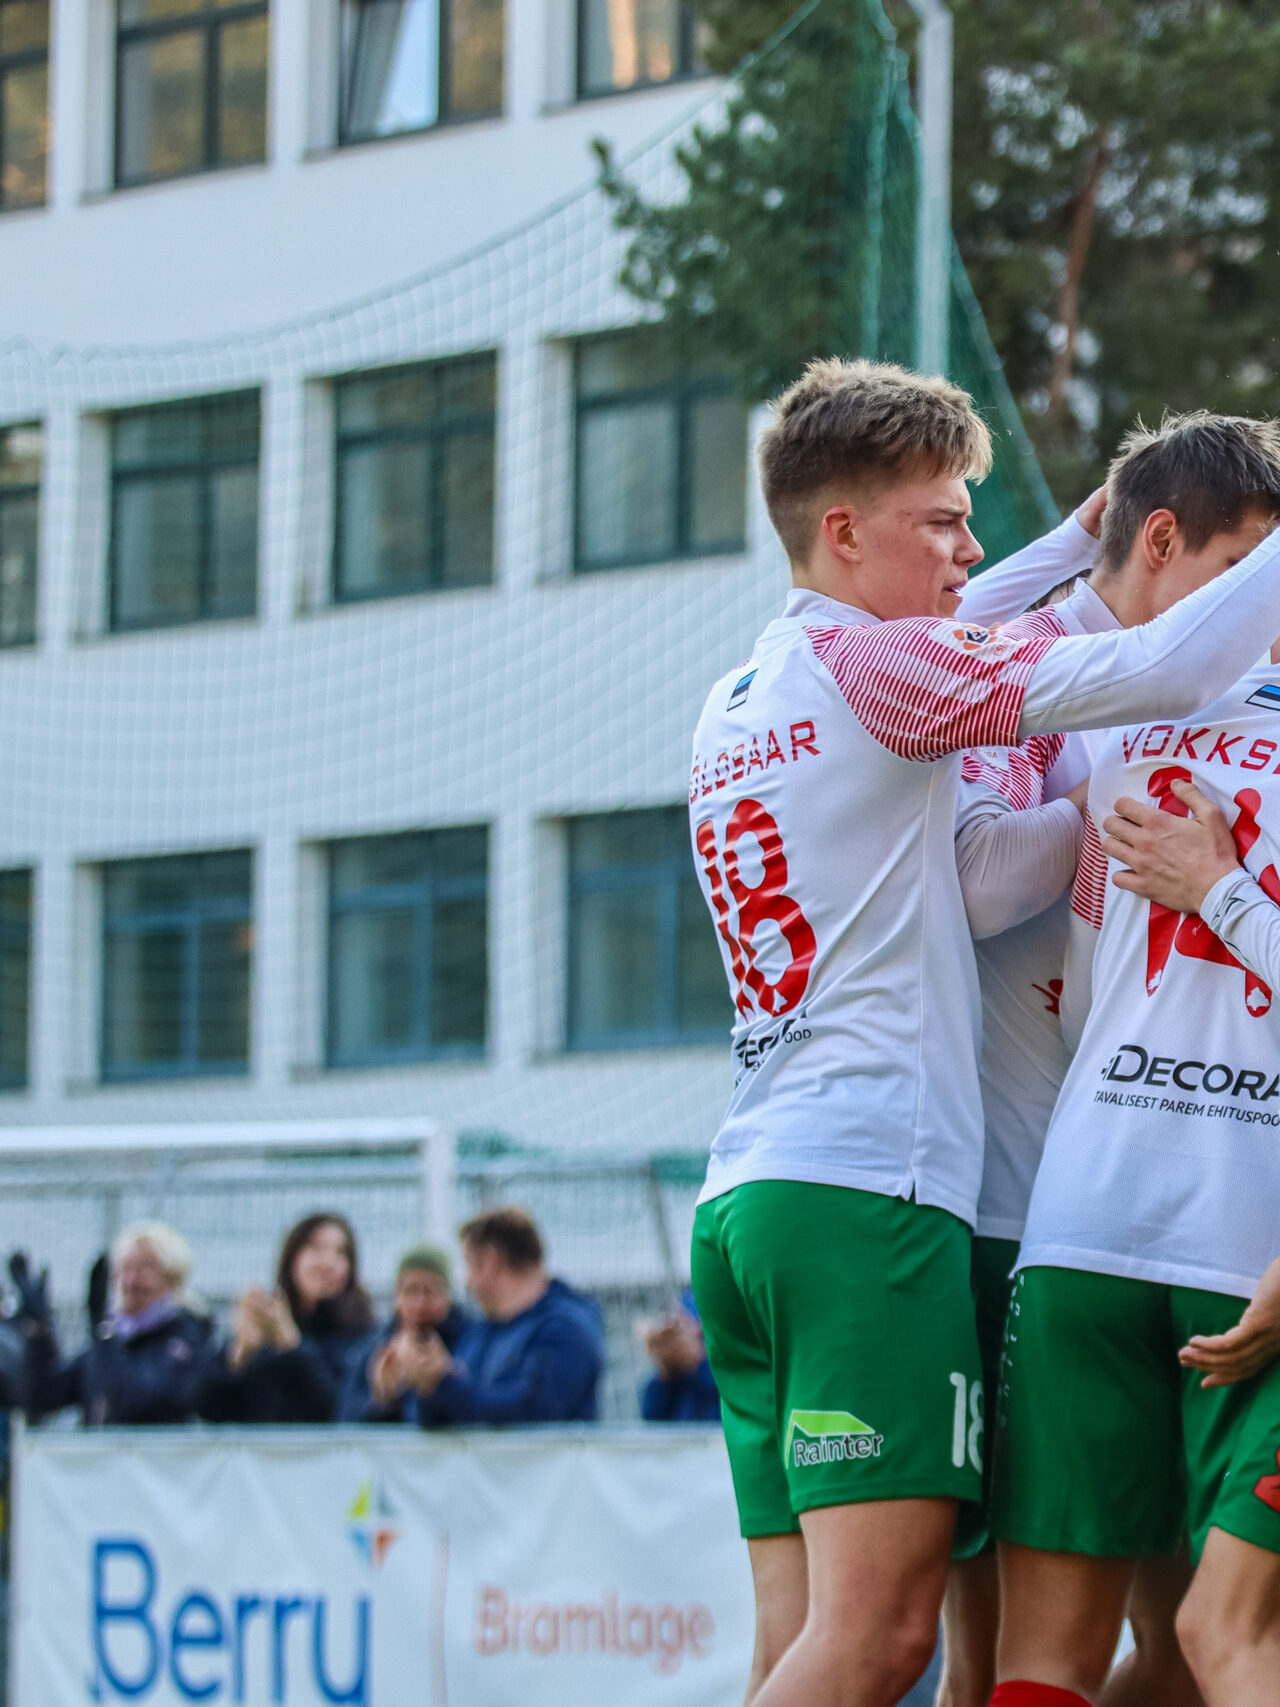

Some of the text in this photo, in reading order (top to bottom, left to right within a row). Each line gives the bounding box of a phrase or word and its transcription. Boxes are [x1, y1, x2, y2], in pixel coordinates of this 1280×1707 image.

[696, 798, 818, 1024] 18
[1093, 1090, 1159, 1110] TAVALISEST
[1159, 1098, 1204, 1117] PAREM
[793, 1433, 884, 1467] Rainter
[88, 1534, 374, 1707] Berry
[474, 1585, 718, 1676] Bramlage
